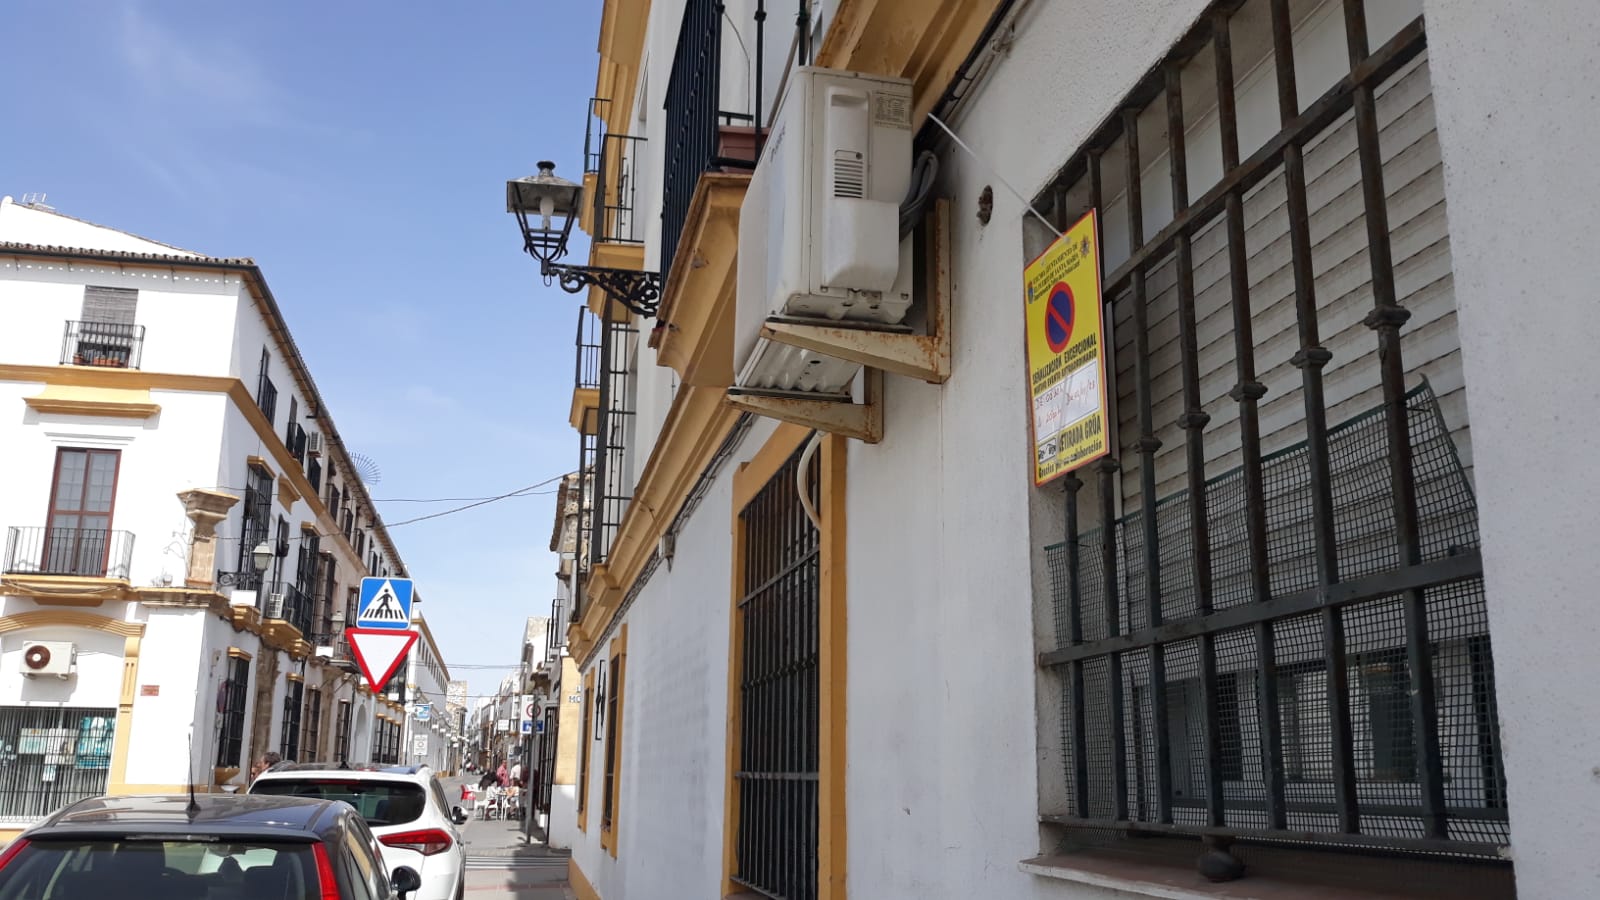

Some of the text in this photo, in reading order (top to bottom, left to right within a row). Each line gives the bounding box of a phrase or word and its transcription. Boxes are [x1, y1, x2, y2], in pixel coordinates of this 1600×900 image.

[1033, 332, 1097, 384] SEÑALIZACIÓN EXCEPCIONAL
[1047, 370, 1061, 387] EVENTO
[1061, 347, 1097, 377] EXTRAORDINARIO
[1085, 414, 1102, 440] GRÚA
